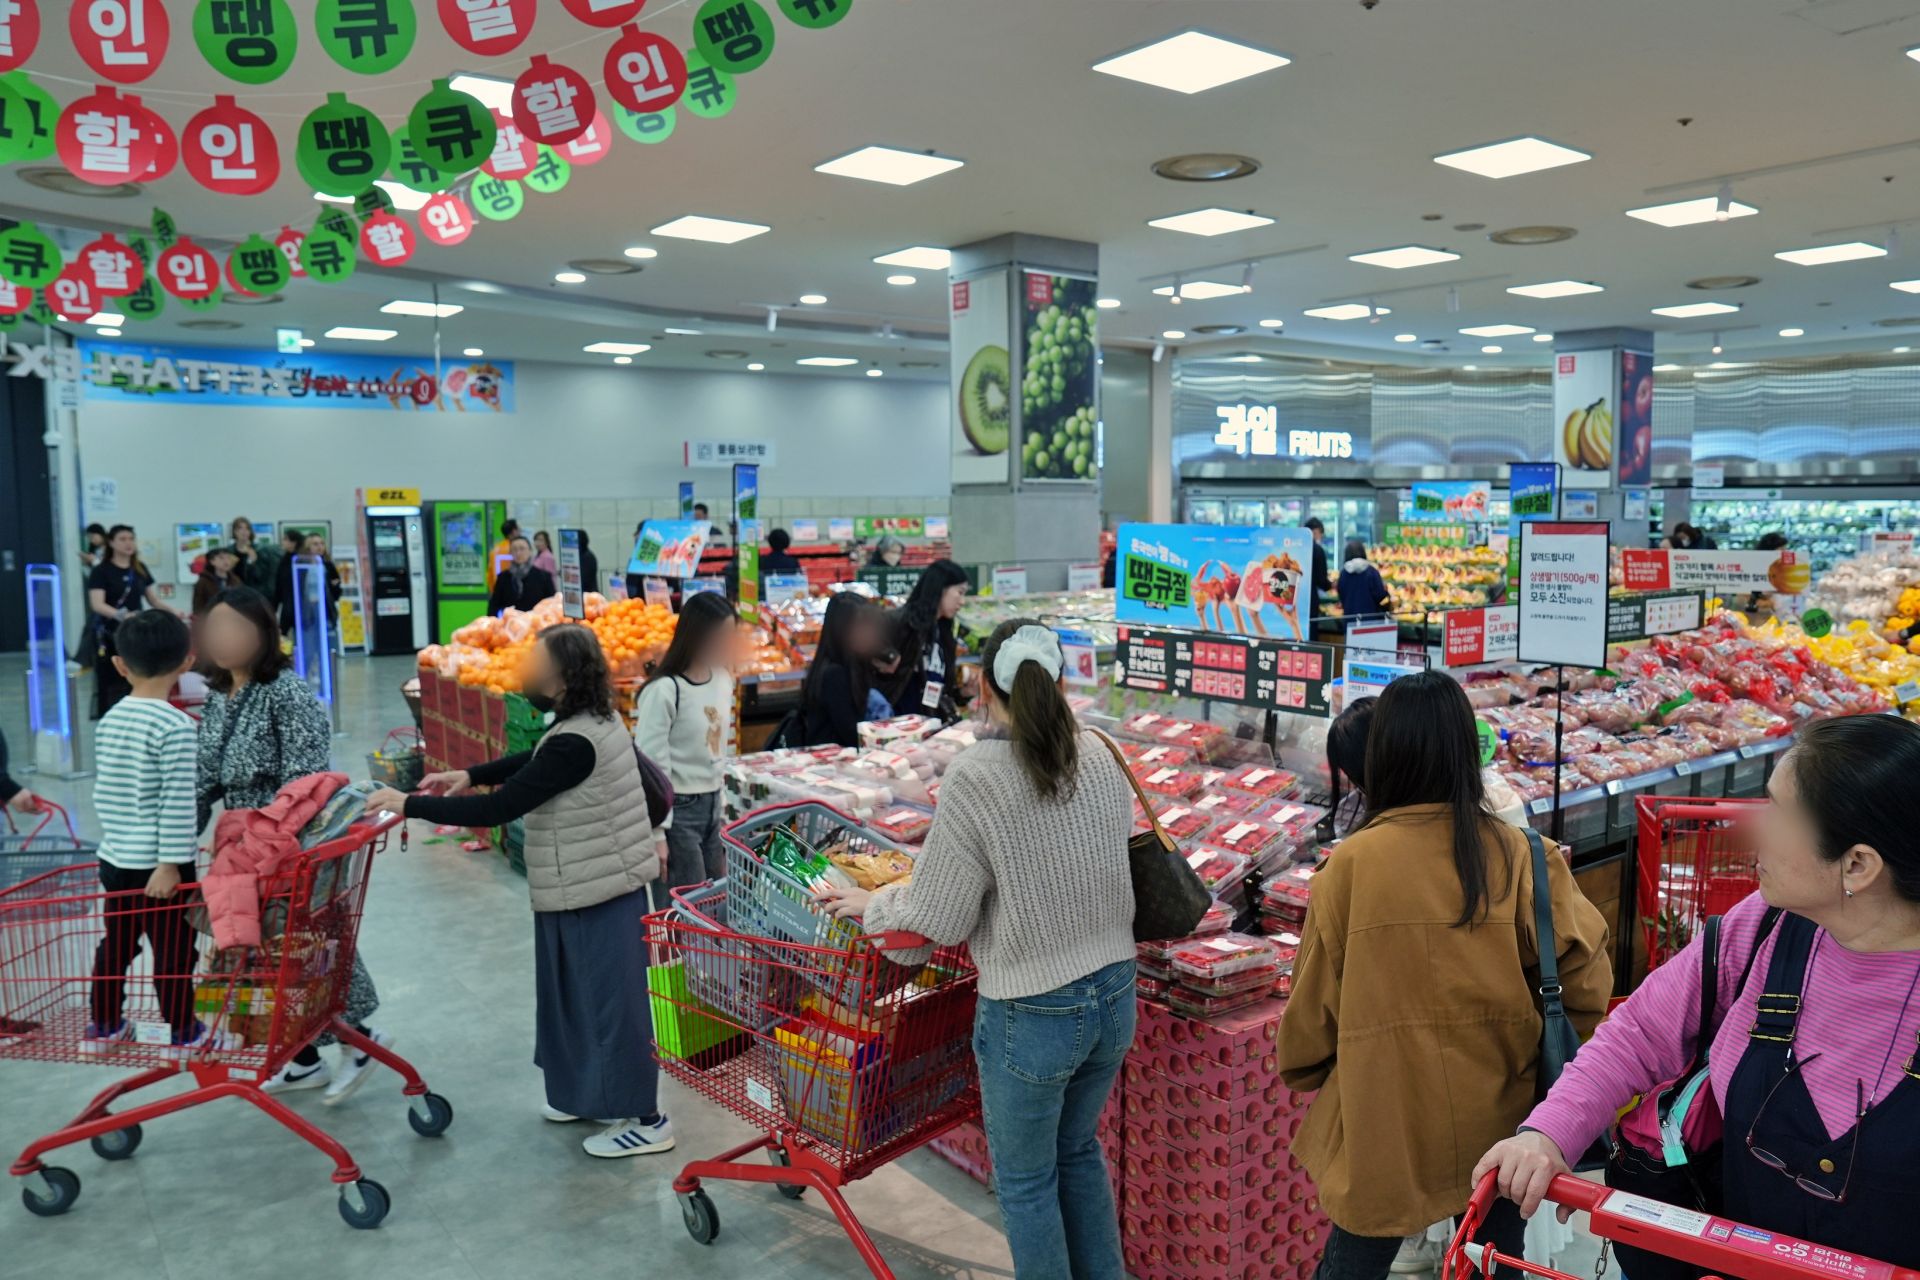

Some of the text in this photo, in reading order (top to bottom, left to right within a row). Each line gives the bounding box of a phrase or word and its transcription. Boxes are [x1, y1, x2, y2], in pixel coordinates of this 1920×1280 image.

[88, 0, 149, 65] 인
[211, 0, 279, 67] 땡
[333, 0, 398, 59] 큐
[74, 111, 140, 173] 할
[200, 123, 257, 180] 인
[313, 116, 374, 176] 땡
[426, 104, 482, 162] 큐
[521, 77, 580, 137] 할
[617, 45, 674, 103] 인
[702, 3, 763, 63] 땡
[477, 151, 560, 212] 땡 큐
[4, 239, 49, 278] 큐
[88, 250, 132, 289] 할
[168, 254, 208, 291] 인
[240, 249, 280, 285] 땡
[310, 241, 346, 276] 큐
[367, 222, 406, 261] 할
[427, 200, 465, 239] 인
[55, 278, 93, 314] 인
[1215, 403, 1352, 459] 과일 FRUITS
[1530, 553, 1575, 562] 알려드립니다!
[1530, 571, 1600, 584] 상생딸기(500g/팩)
[1129, 558, 1187, 603] 땡큐절
[1530, 592, 1548, 603] 모두
[1774, 1243, 1808, 1257] GO
